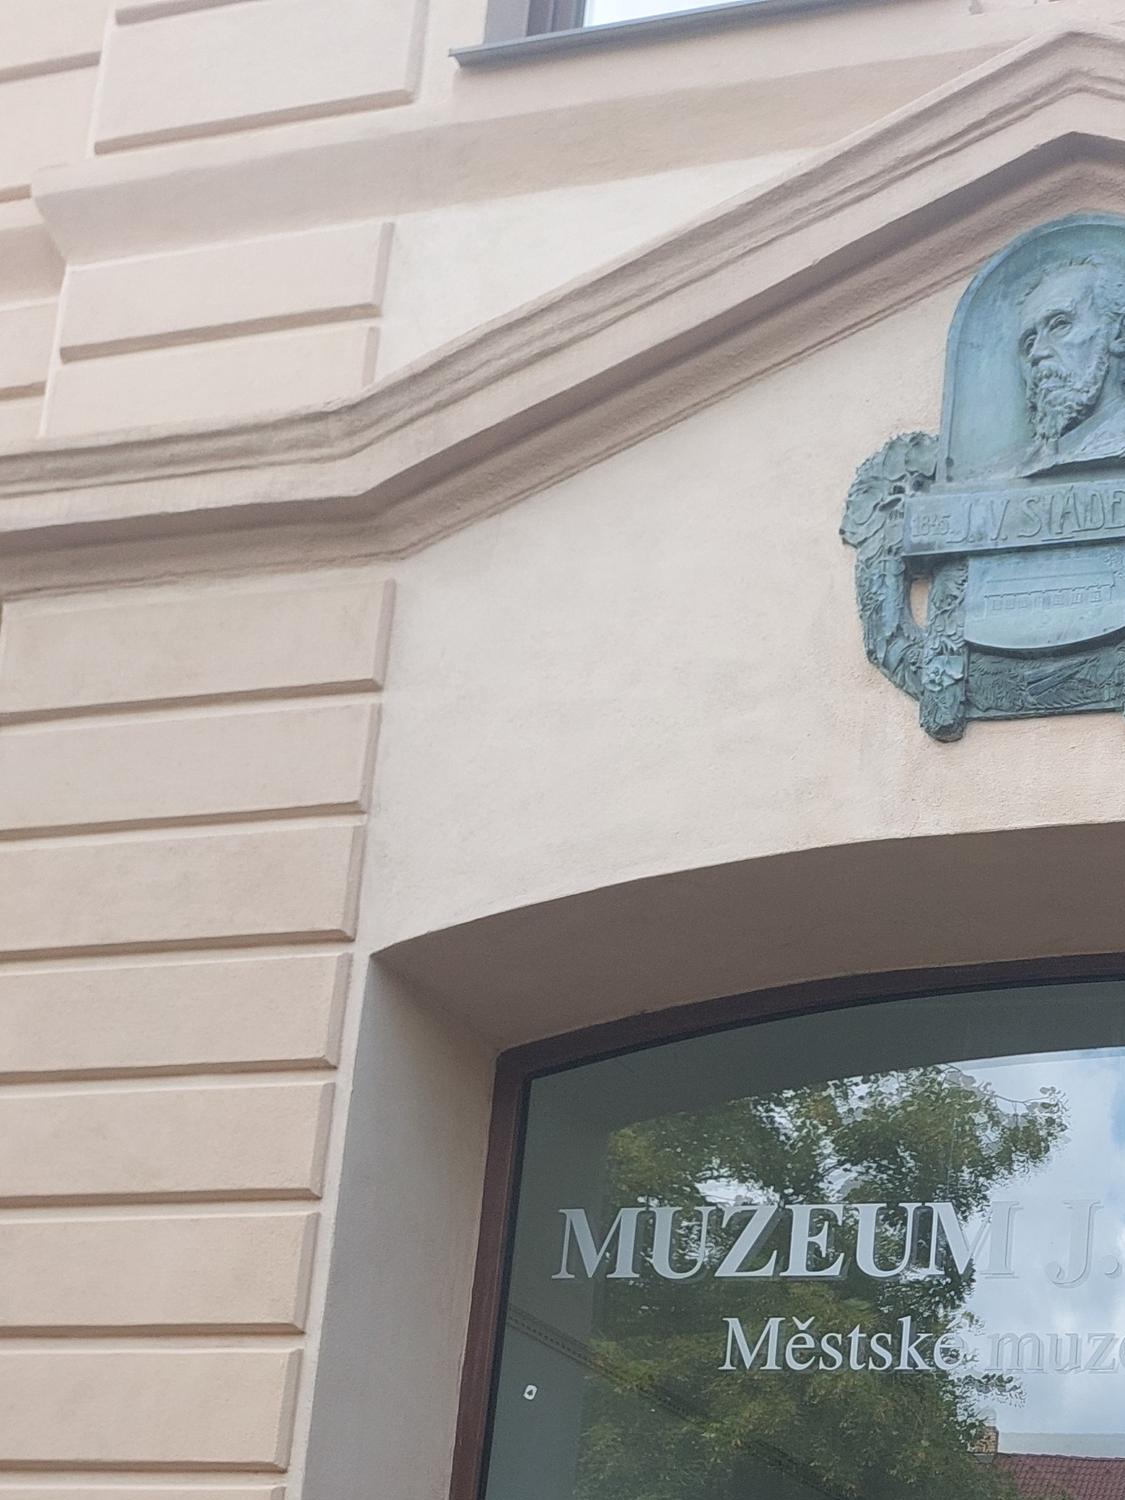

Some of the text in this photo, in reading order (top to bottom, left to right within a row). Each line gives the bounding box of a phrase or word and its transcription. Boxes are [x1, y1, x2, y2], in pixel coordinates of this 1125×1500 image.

[552, 1200, 1023, 1281] MUZEUM
[1046, 1200, 1121, 1285] J.
[719, 1315, 965, 1373] Městské
